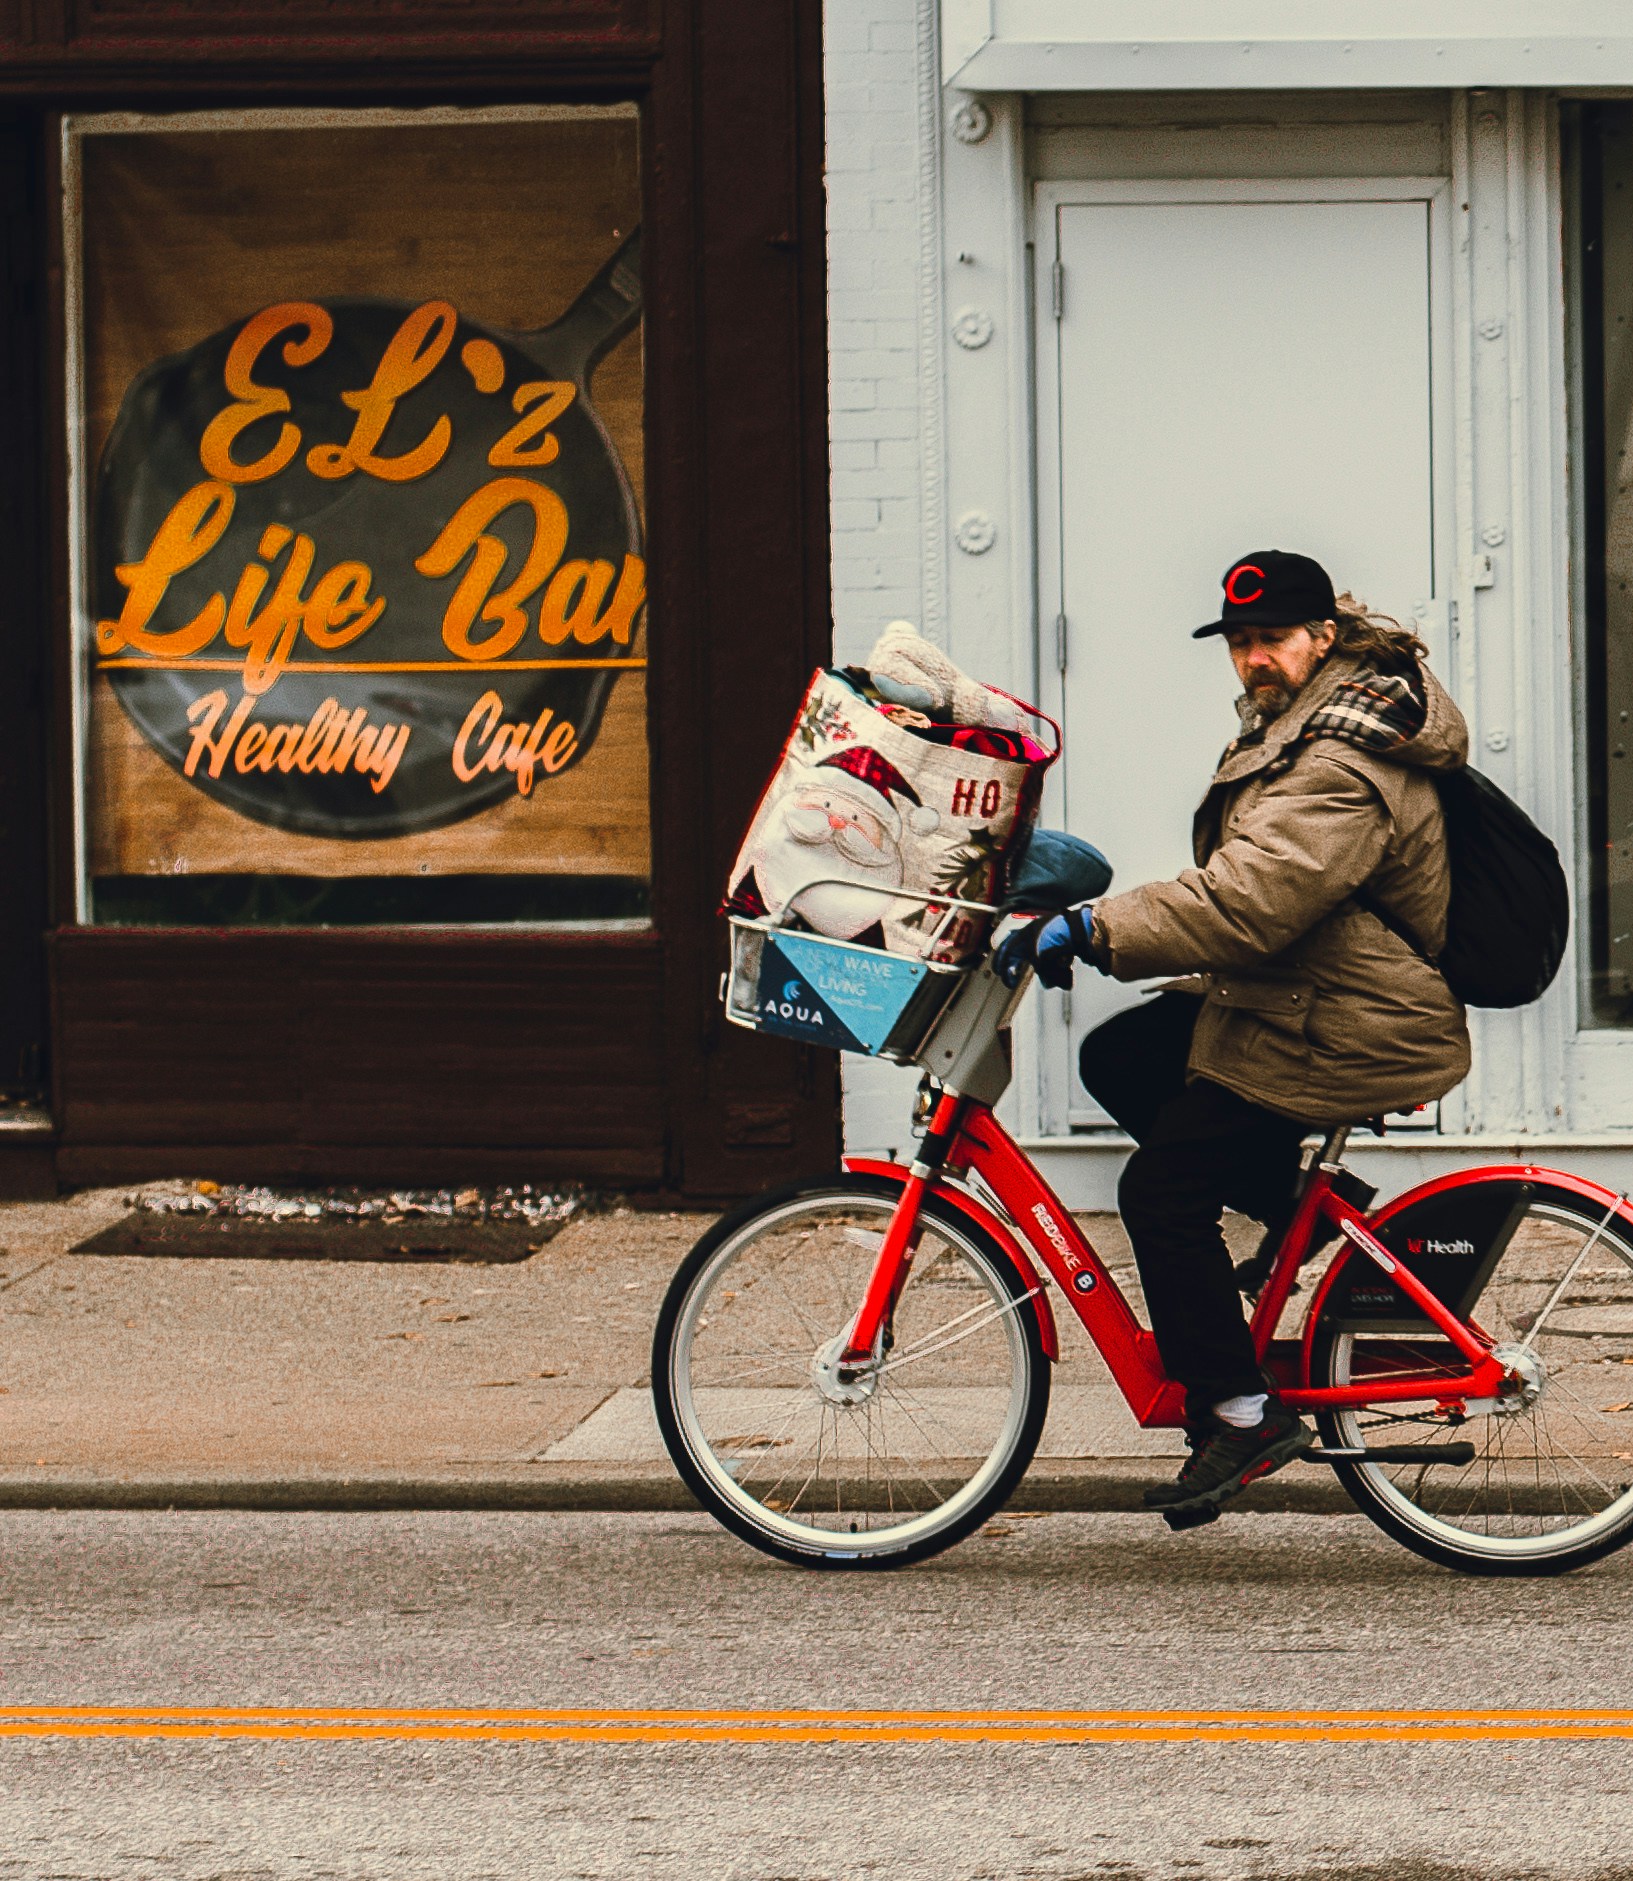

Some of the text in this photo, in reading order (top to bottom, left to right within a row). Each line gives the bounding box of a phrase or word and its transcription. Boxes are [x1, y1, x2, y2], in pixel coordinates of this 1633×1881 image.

[96, 481, 387, 695] Life
[1226, 565, 1266, 605] C
[184, 690, 579, 796] Healthy Cafe
[951, 777, 1003, 819] HO
[843, 955, 895, 979] WAVE
[764, 999, 824, 1026] AQUA
[1427, 1239, 1475, 1255] Health
